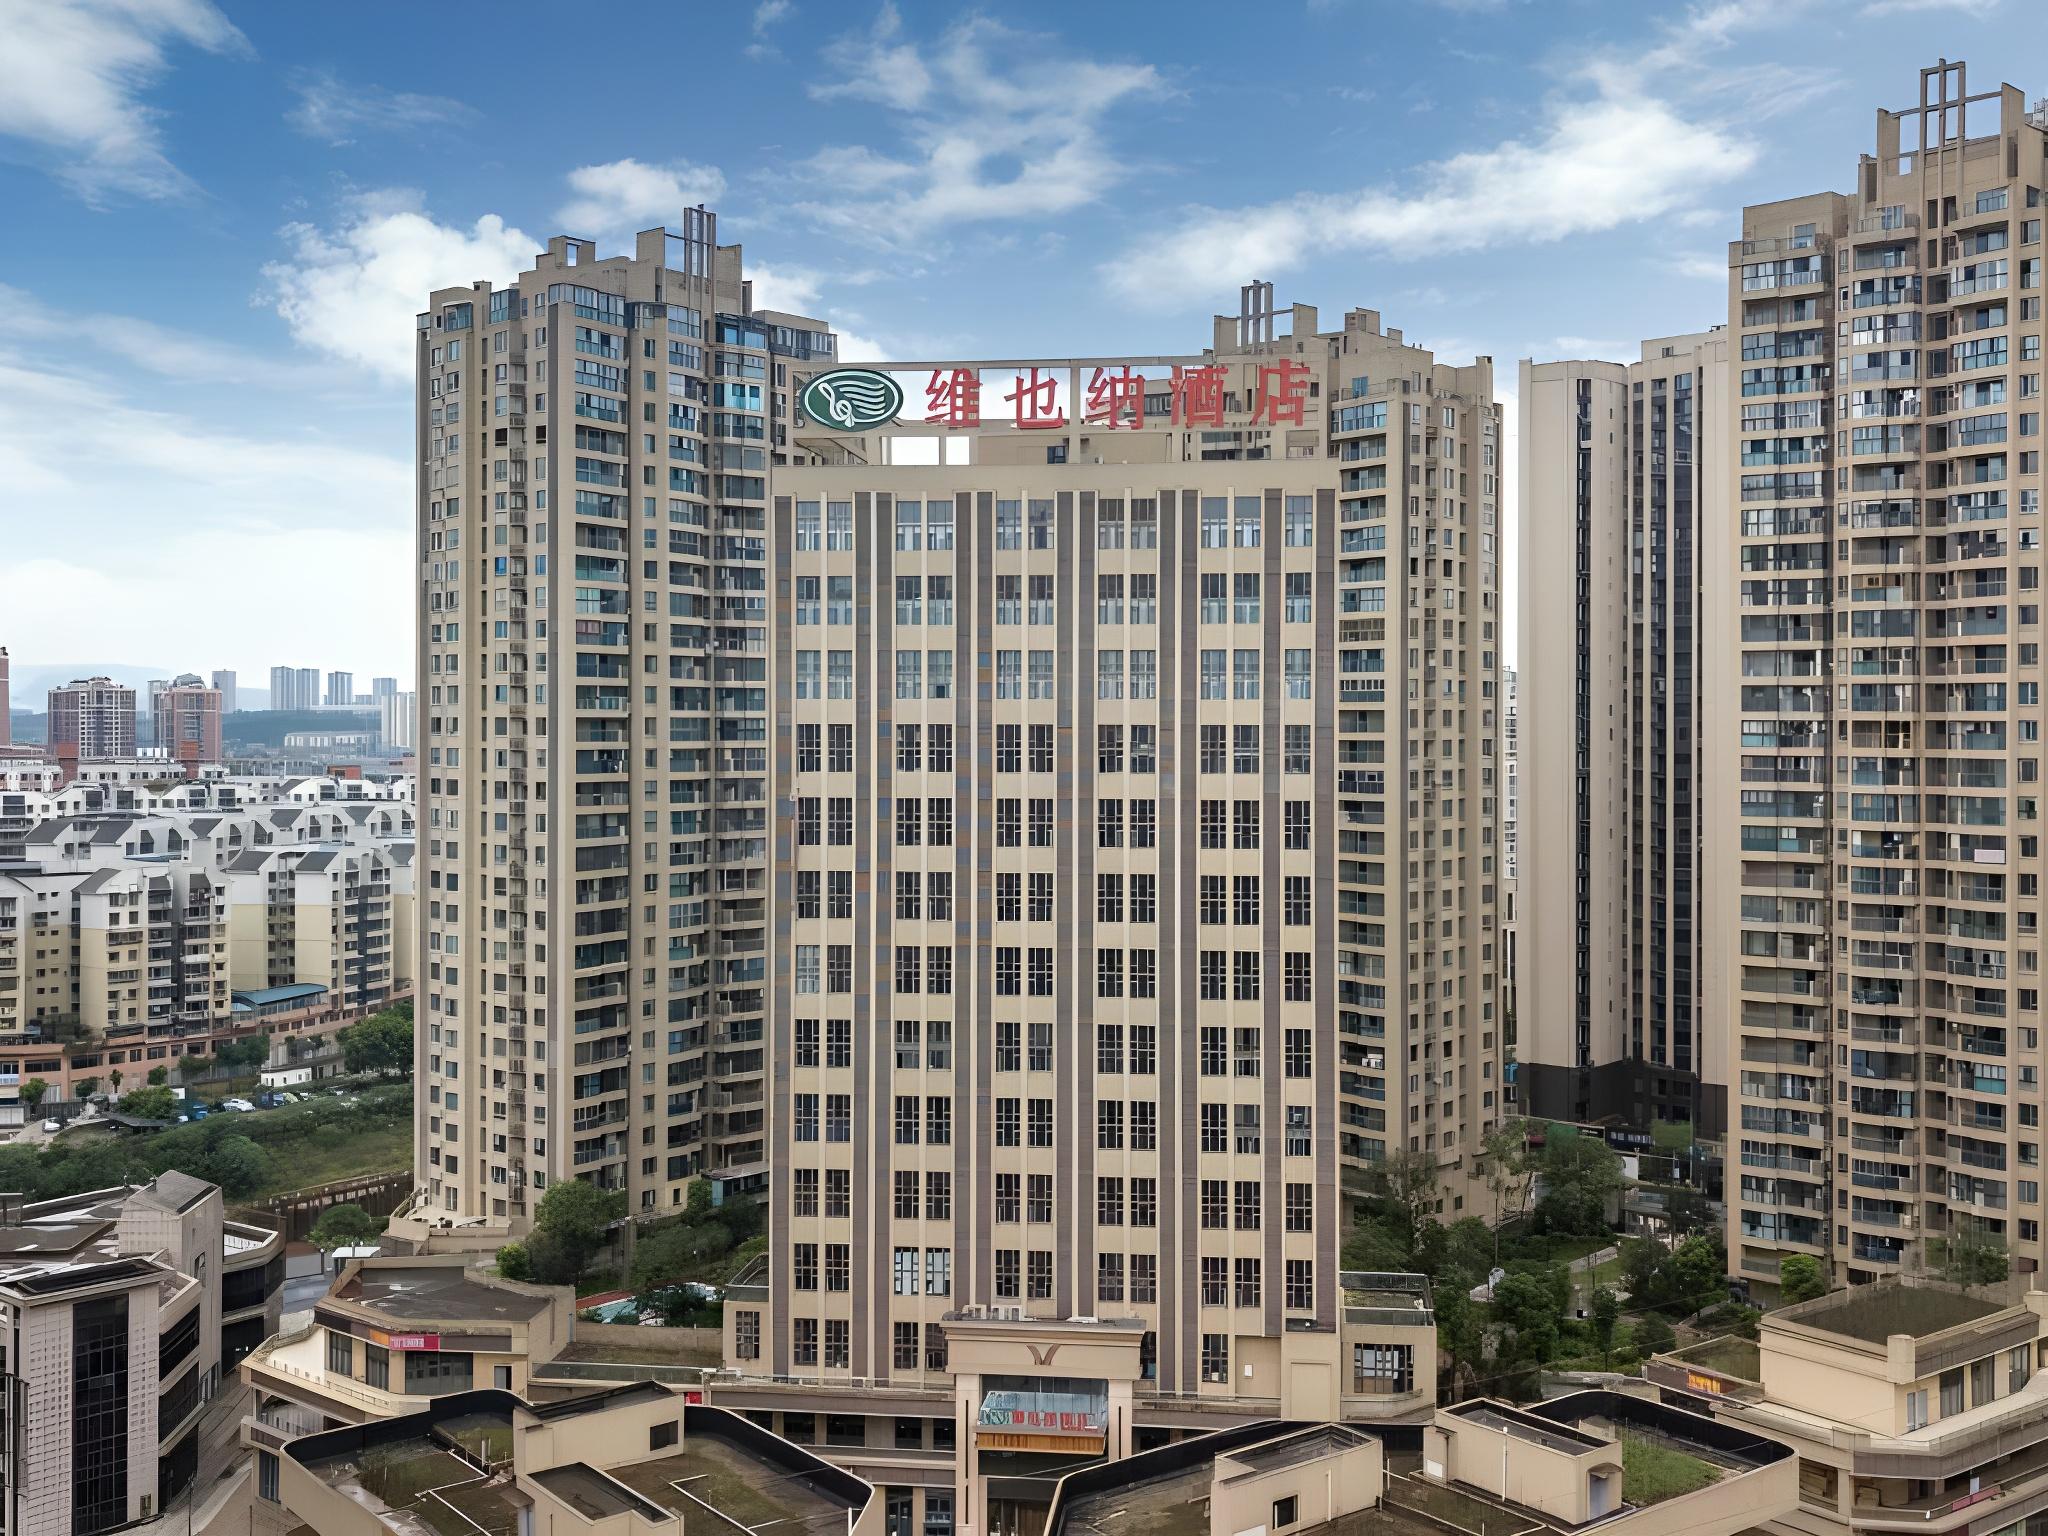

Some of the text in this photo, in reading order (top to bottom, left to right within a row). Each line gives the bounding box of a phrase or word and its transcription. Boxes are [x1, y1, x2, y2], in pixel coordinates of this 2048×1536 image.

[925, 359, 1311, 429] 维也纳酒店
